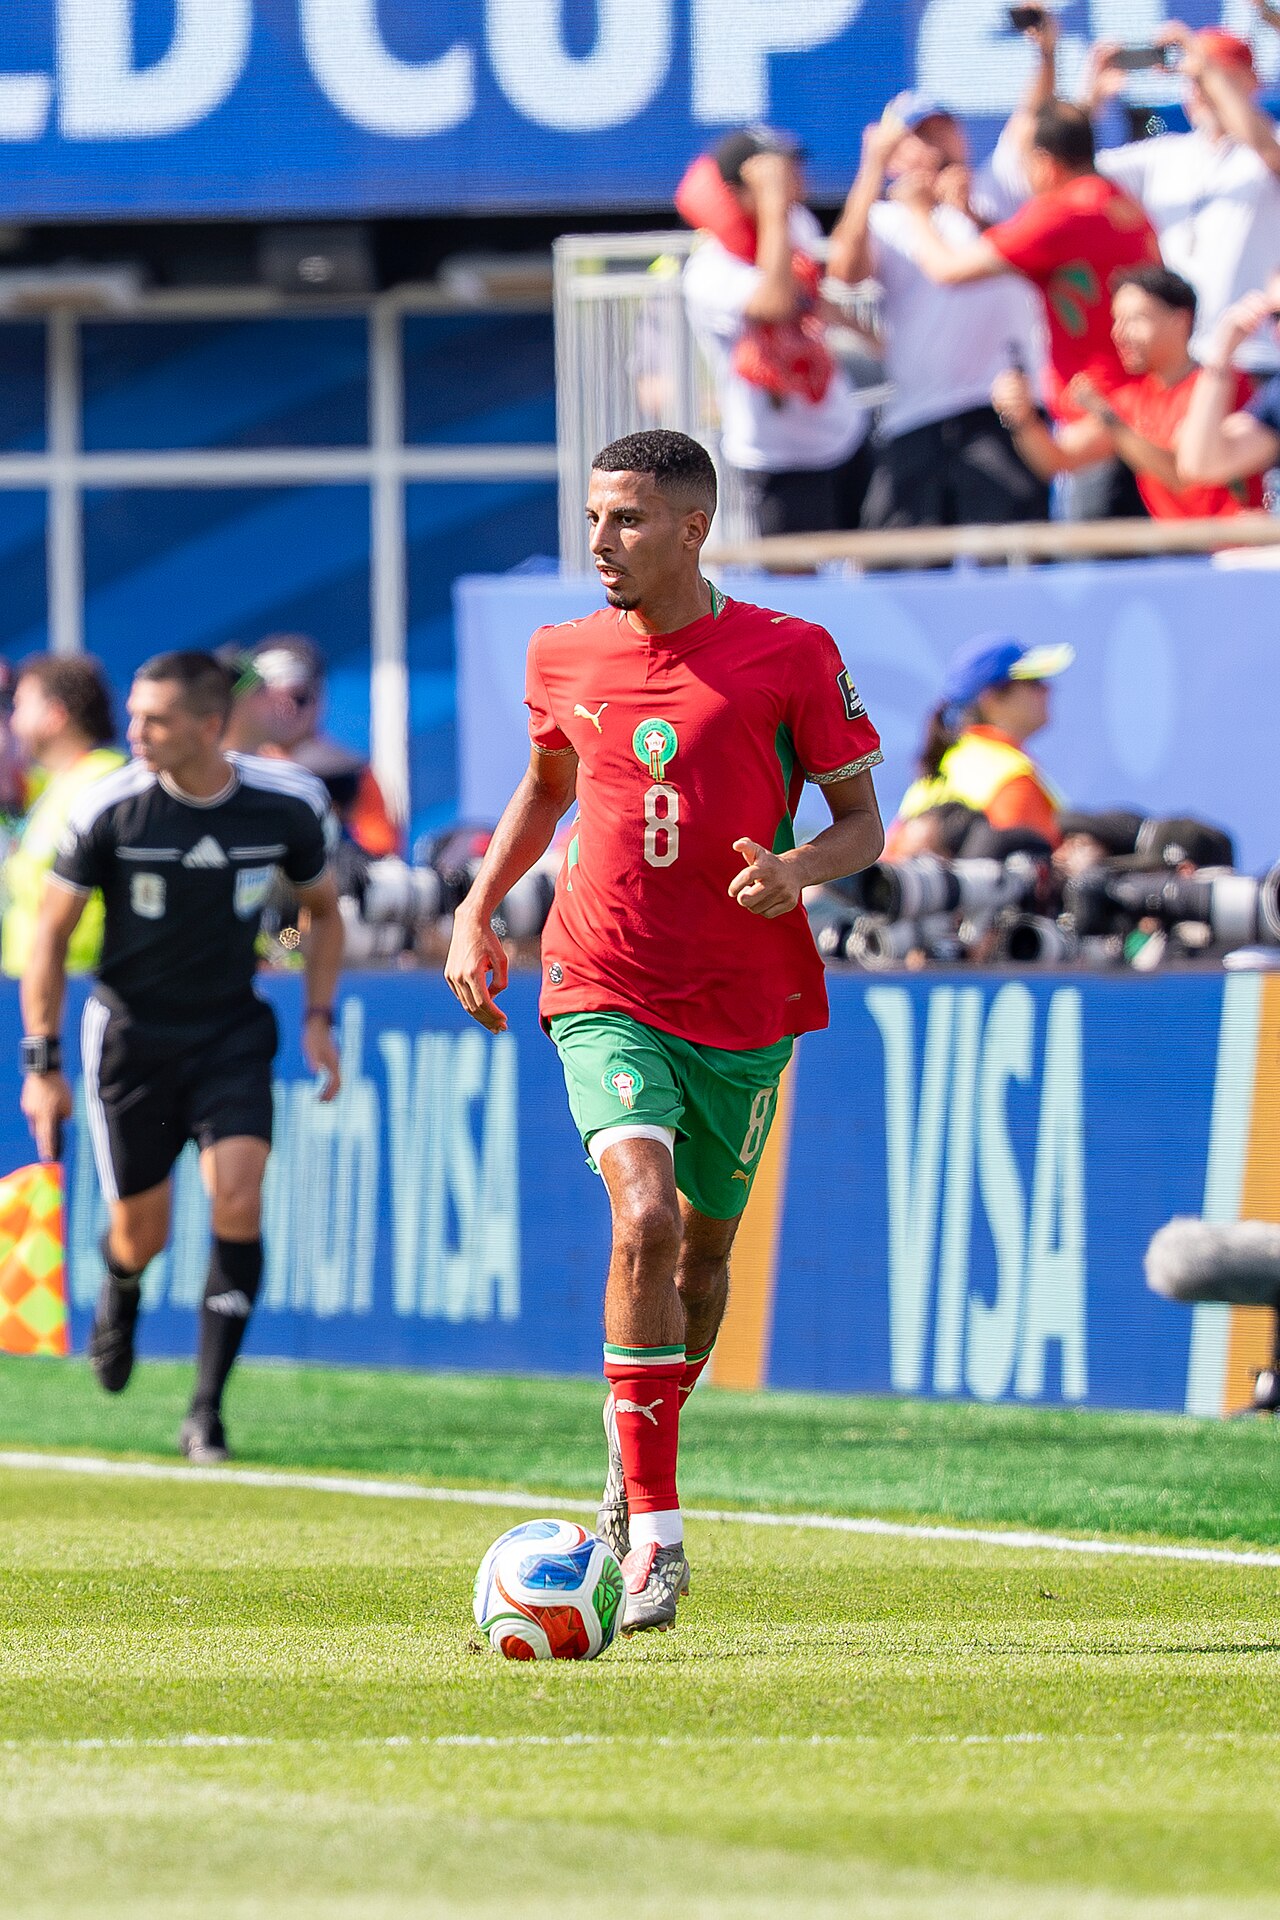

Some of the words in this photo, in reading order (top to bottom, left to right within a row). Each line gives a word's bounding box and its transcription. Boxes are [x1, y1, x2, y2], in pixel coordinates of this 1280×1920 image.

[298, 0, 868, 138] CUP
[644, 784, 679, 867] 8
[378, 1028, 522, 1322] VISA
[739, 1087, 774, 1165] 8
[864, 980, 1088, 1401] VISA
